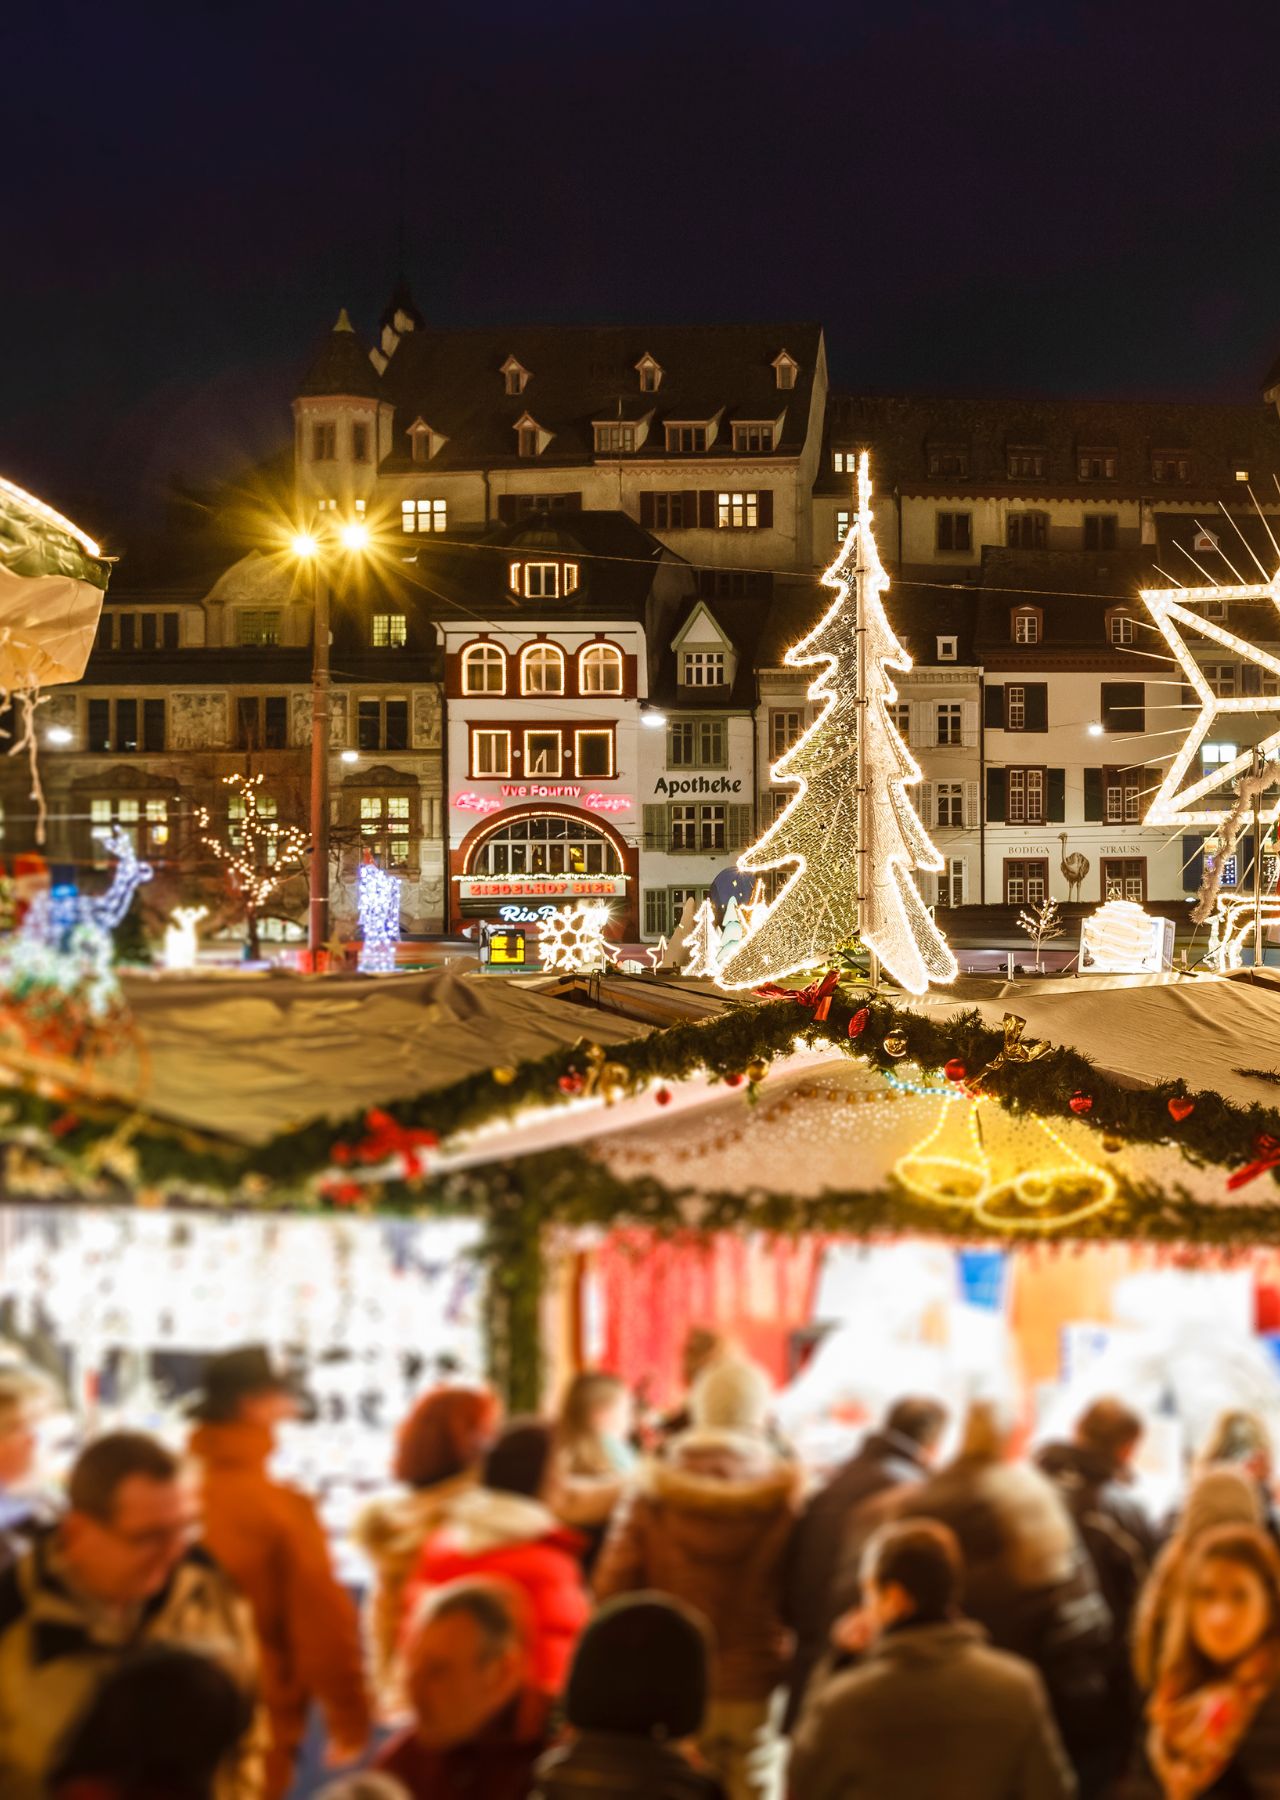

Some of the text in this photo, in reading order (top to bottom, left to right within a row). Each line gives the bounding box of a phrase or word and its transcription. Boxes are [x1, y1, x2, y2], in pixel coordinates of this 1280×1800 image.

[501, 784, 582, 799] Vve Fourny
[654, 776, 742, 798] Apotheke
[1008, 845, 1141, 855] BODEGA STRAUSS
[469, 881, 616, 896] ZIEGELHOF BIER
[499, 905, 539, 922] Rio
